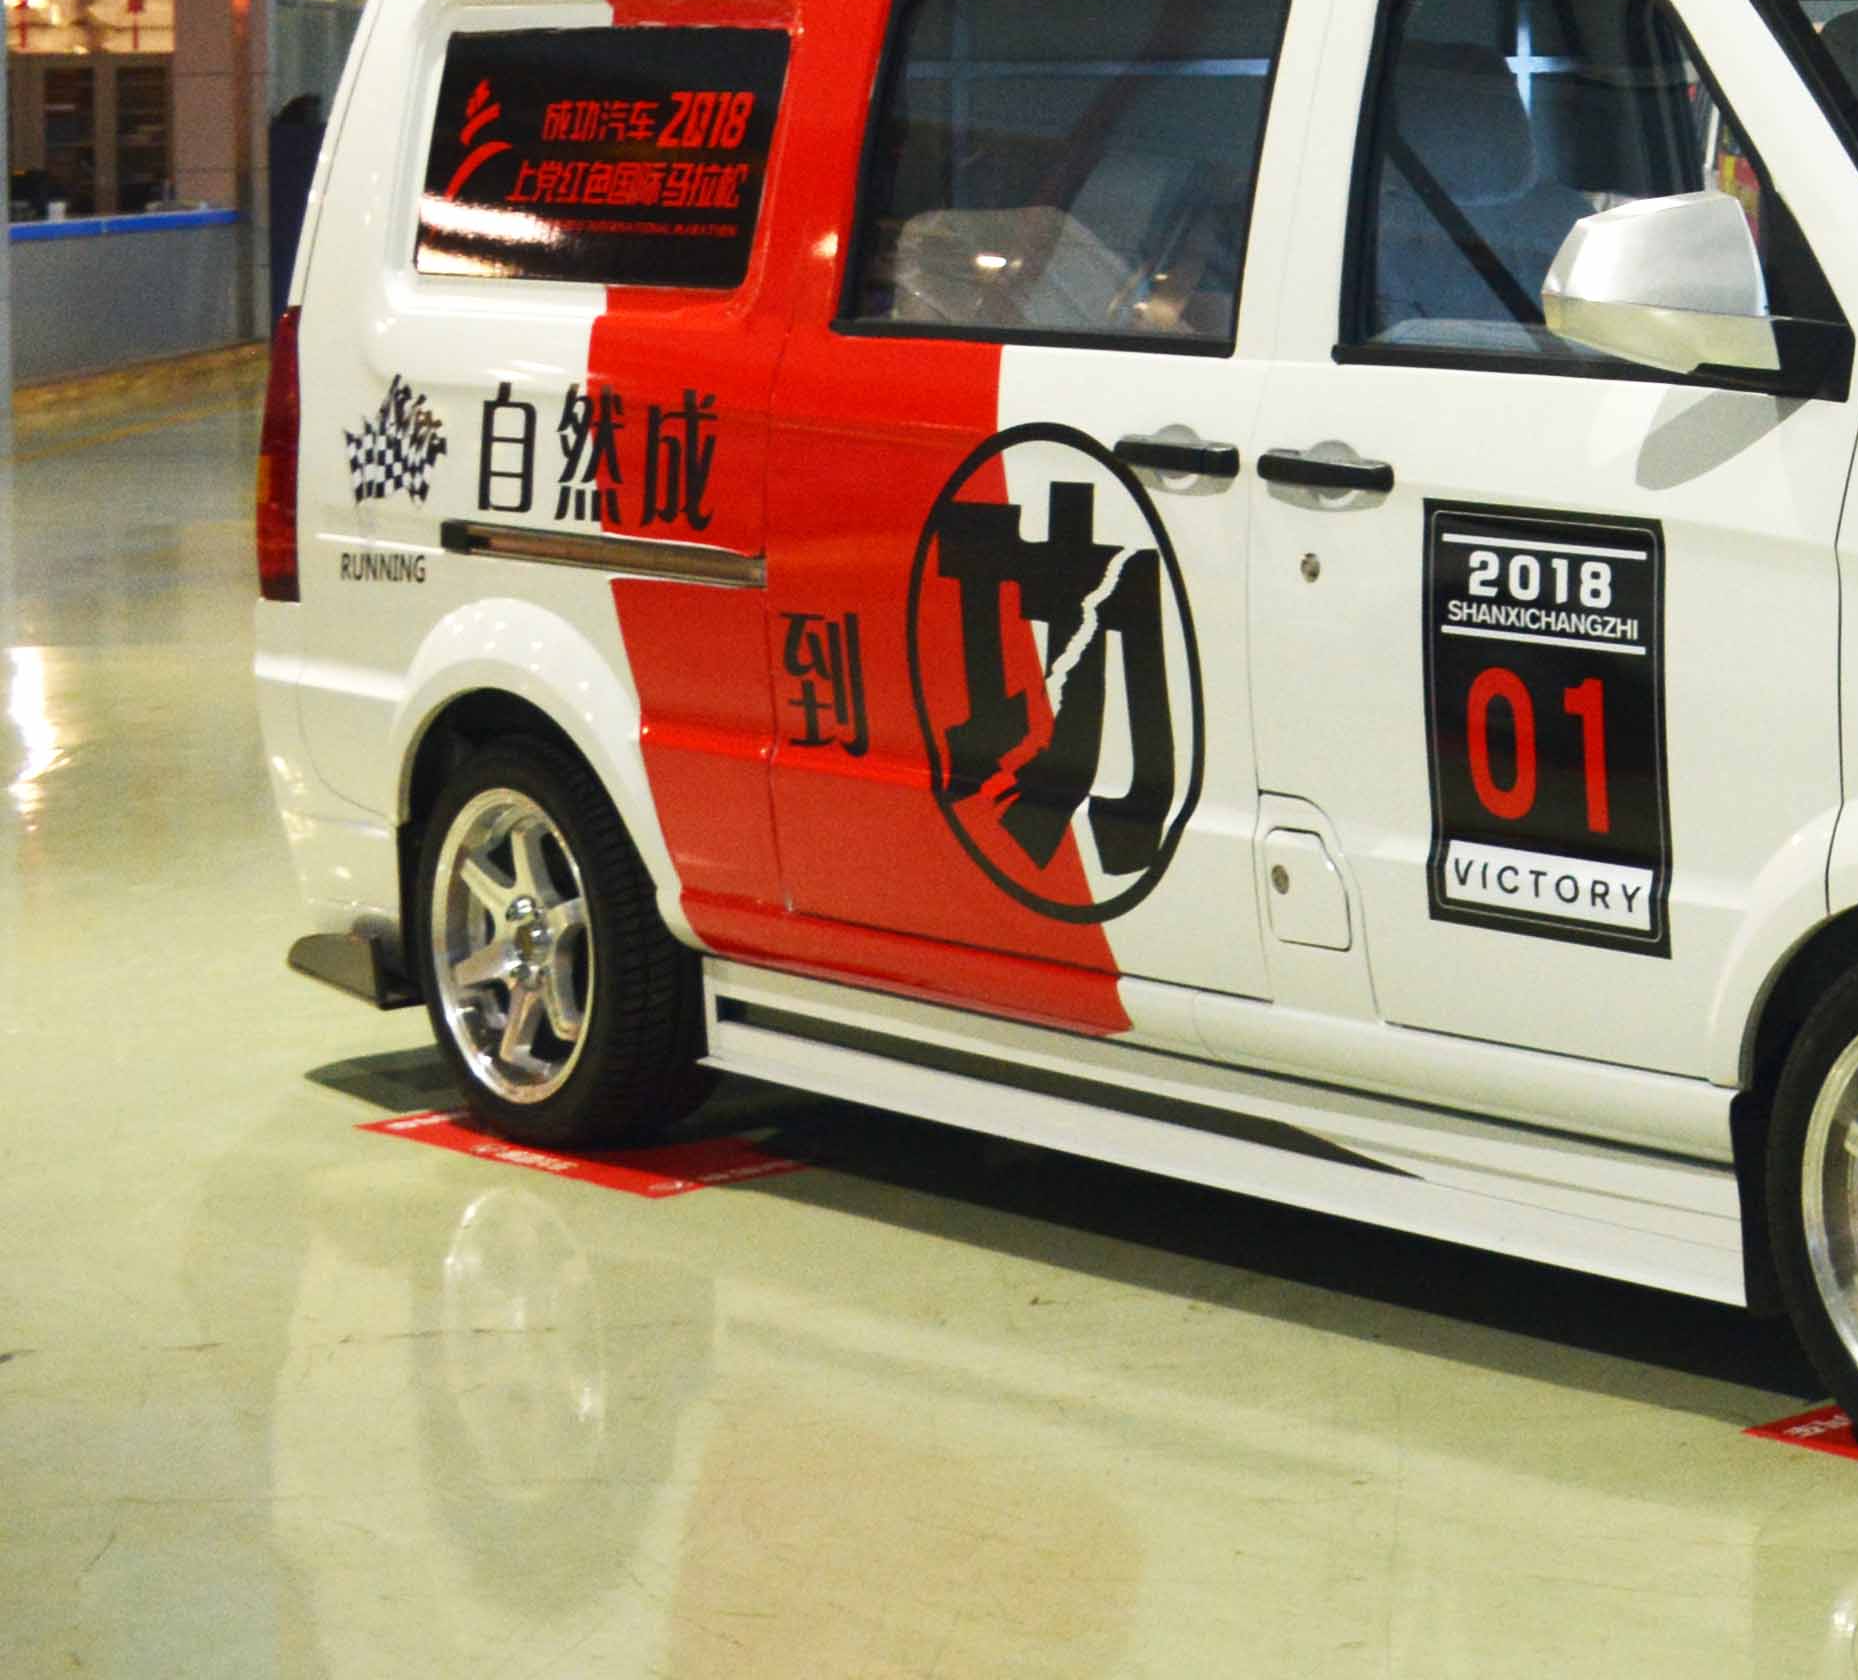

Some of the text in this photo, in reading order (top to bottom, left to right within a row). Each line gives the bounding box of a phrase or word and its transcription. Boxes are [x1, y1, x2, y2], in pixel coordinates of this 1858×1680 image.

[506, 160, 748, 208] 上党红色国际马拉松
[477, 381, 719, 532] 自然成
[340, 552, 427, 583] RUNNING
[1468, 550, 1612, 609] 2018
[1448, 600, 1638, 640] SHANXICHANGZHI
[778, 611, 866, 756] 到
[1467, 666, 1609, 833] 01
[1454, 857, 1641, 912] VICTORY
